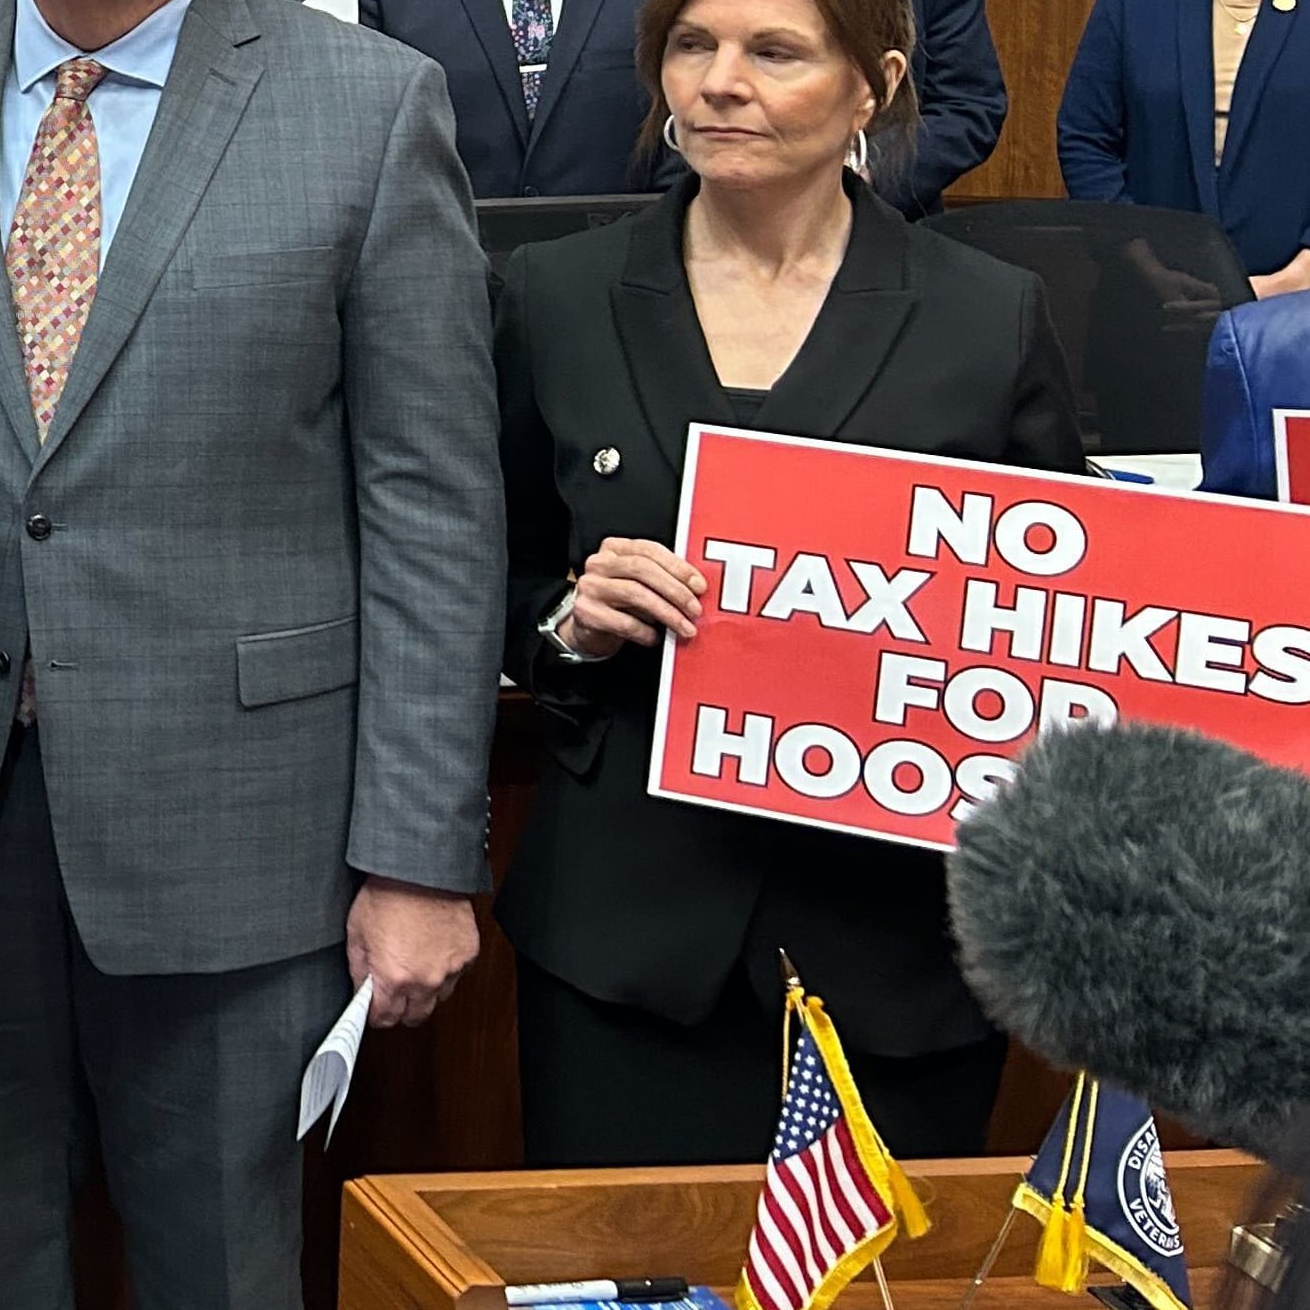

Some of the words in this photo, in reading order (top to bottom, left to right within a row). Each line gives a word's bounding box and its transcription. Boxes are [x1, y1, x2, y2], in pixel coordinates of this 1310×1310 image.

[904, 483, 1088, 578] NO
[702, 537, 936, 646] TAX
[960, 579, 1310, 707] HIKES
